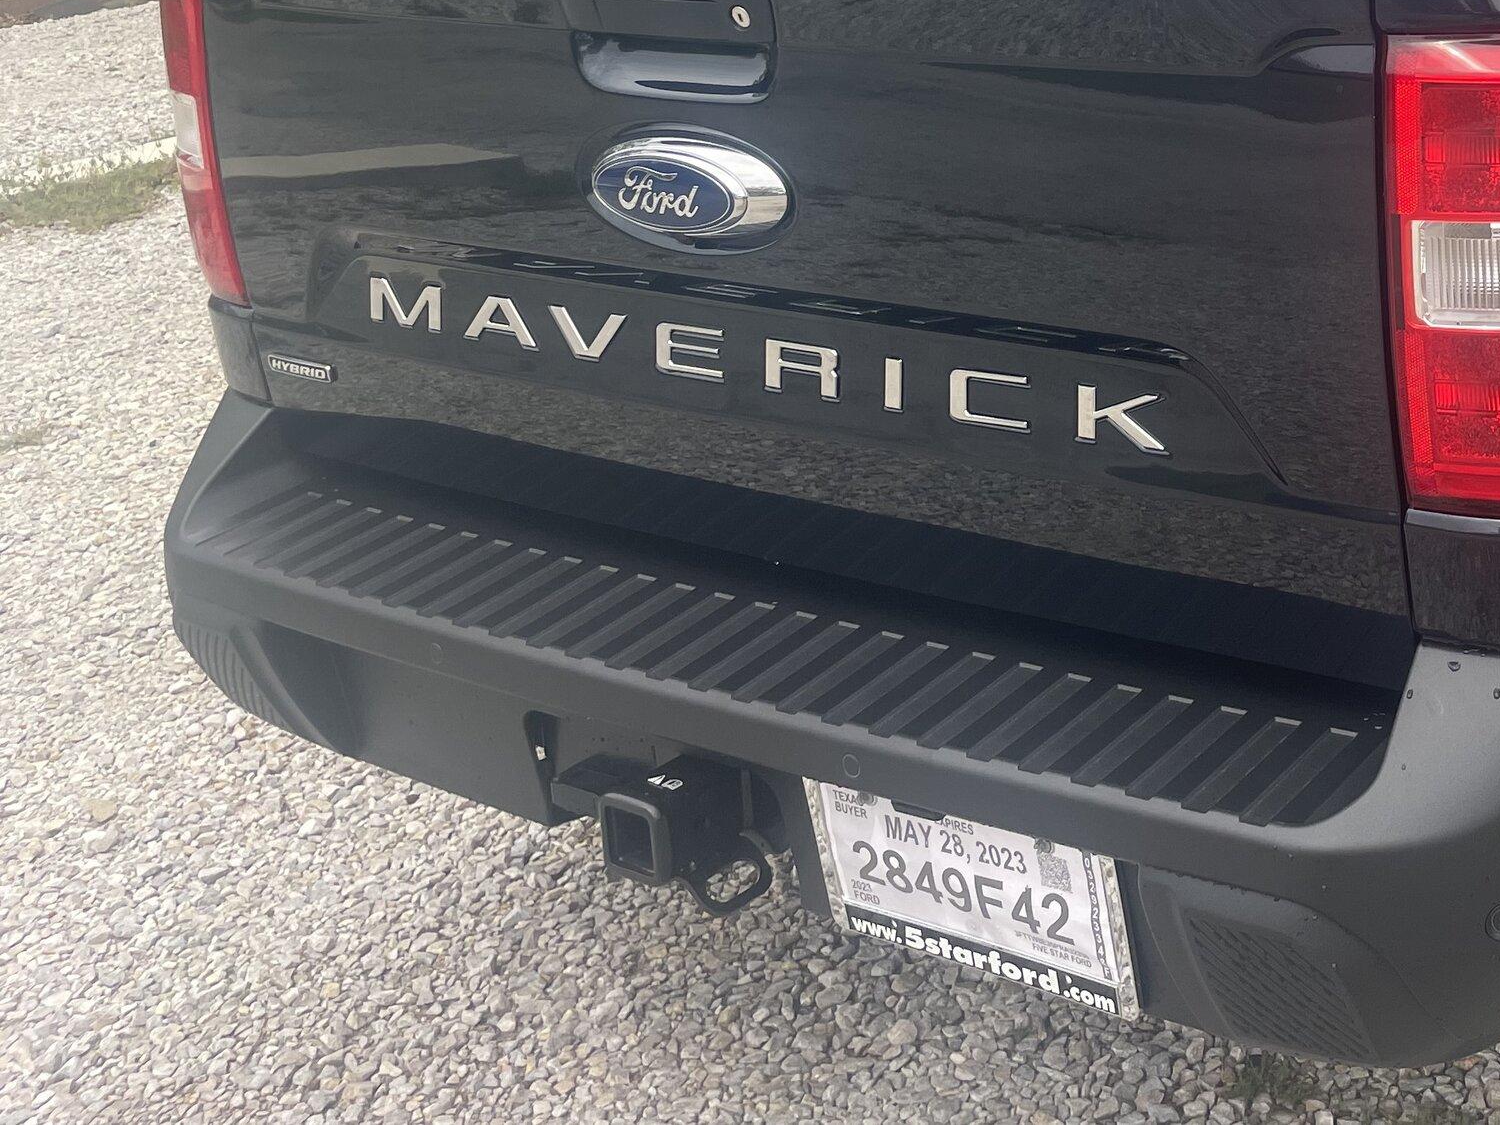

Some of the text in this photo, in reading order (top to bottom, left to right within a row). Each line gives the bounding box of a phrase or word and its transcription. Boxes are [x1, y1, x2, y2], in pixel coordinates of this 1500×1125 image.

[617, 165, 700, 218] Ford
[271, 359, 326, 379] HYBRID
[368, 276, 1171, 456] MAVERICK
[834, 801, 868, 820] BUYER
[885, 814, 1028, 875] MAY 28, 2023
[850, 879, 872, 893] 2023
[852, 840, 1075, 946] 2849F42
[853, 891, 880, 906] FORD
[850, 916, 1116, 1013] www.5starford.com
[1032, 943, 1048, 954] FIVE
[1050, 948, 1070, 961] STAR
[1071, 954, 1092, 968] FORD
